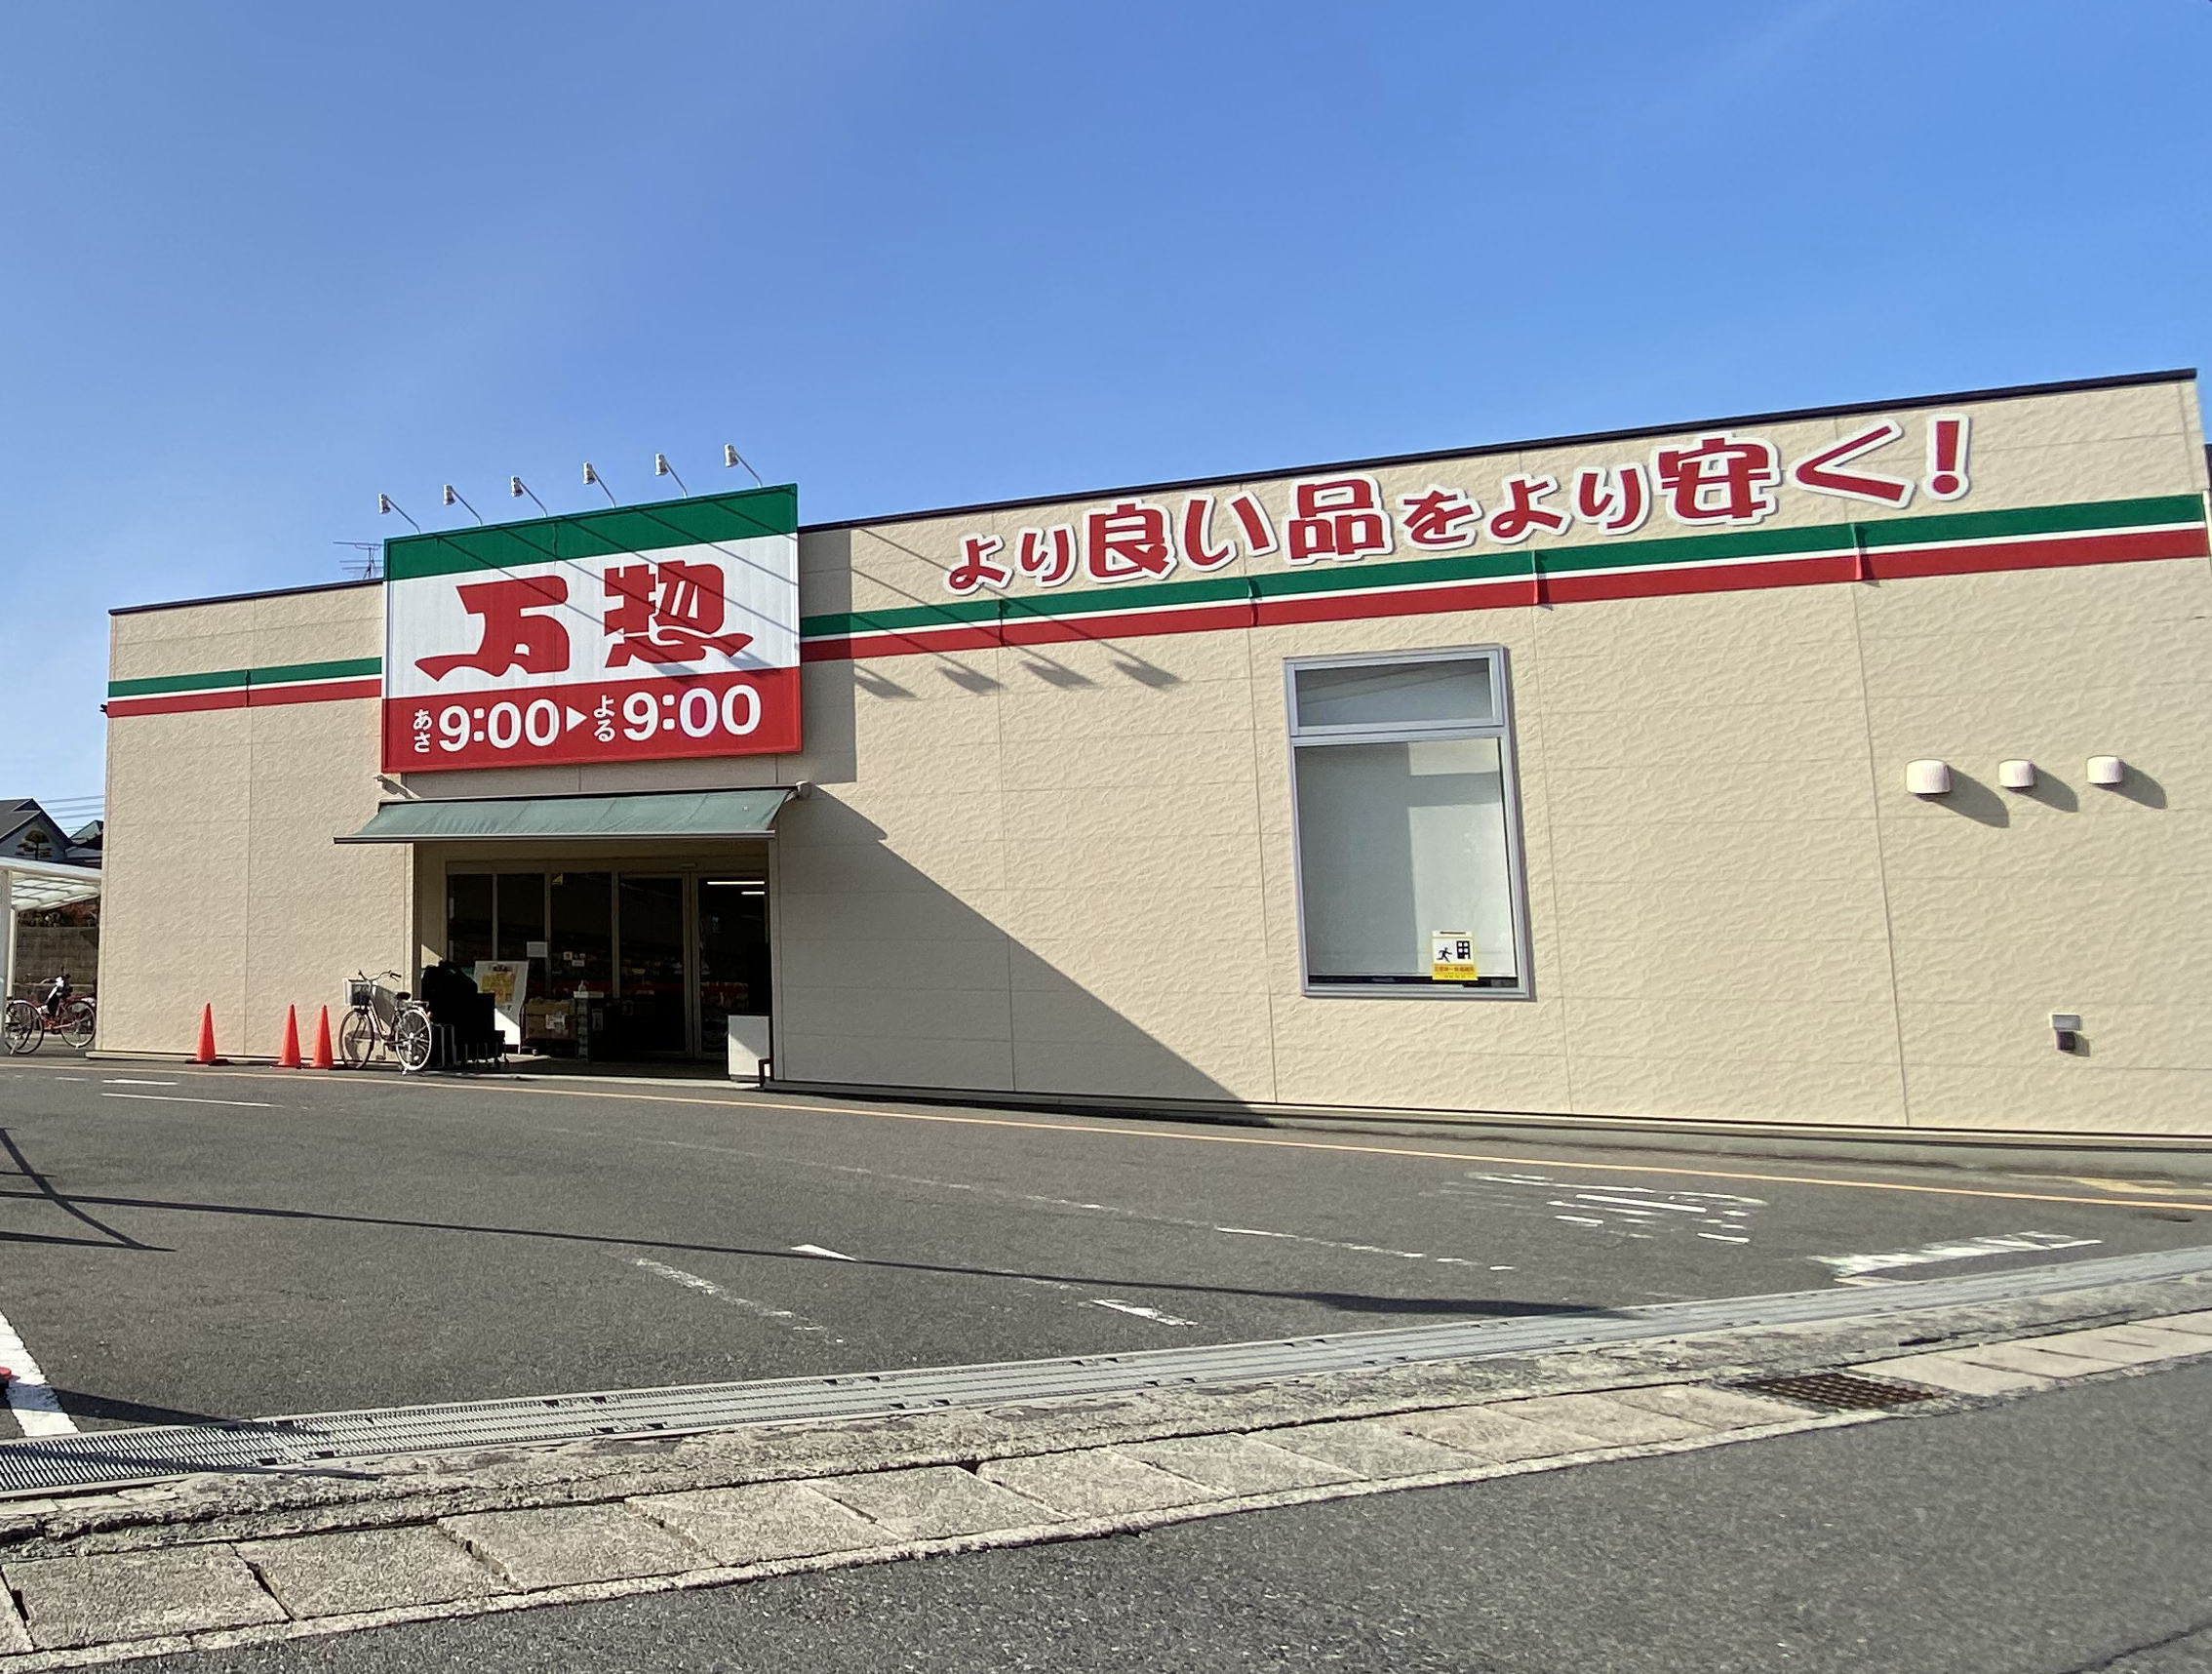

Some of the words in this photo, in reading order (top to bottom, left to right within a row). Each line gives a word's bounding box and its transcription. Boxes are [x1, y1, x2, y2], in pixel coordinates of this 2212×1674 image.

[415, 559, 754, 682] 万惣
[413, 708, 433, 753] あさ
[438, 698, 561, 753] 9:00
[592, 694, 616, 742] よる
[622, 684, 762, 741] 9:00
